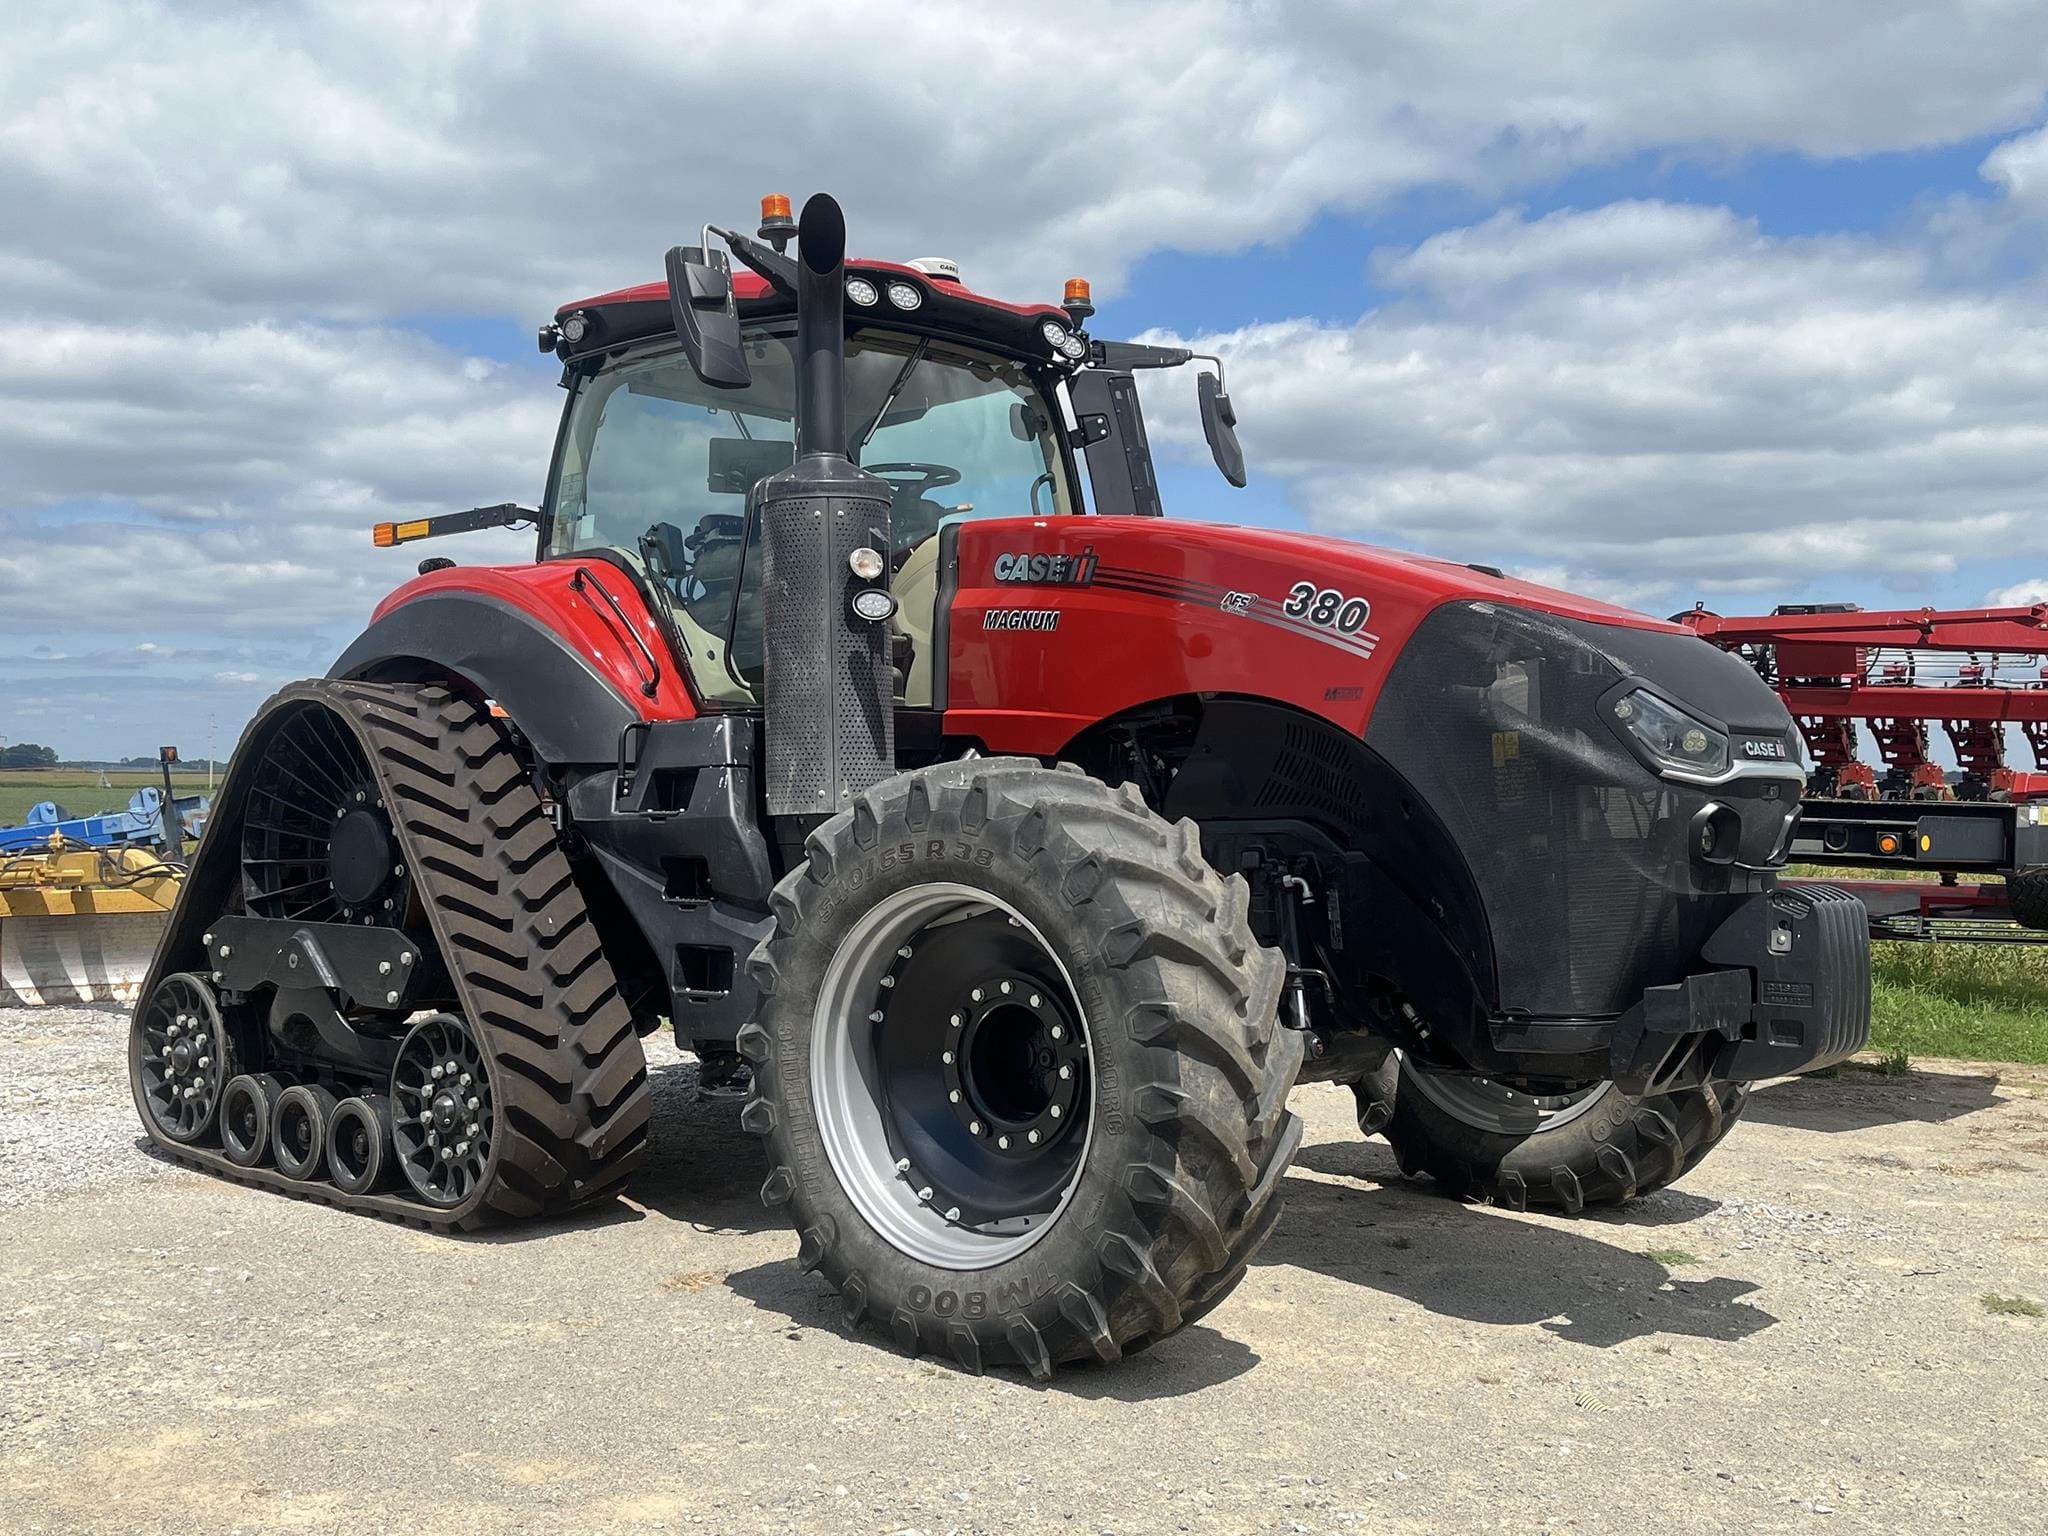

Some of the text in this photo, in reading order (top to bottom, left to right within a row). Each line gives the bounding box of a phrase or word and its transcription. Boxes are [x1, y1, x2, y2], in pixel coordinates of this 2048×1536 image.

[994, 552, 1069, 582] CASE
[1221, 591, 1251, 609] AFS
[1283, 581, 1370, 636] 380
[983, 610, 1060, 630] MAGNUM
[1745, 741, 1776, 757] CASE
[925, 839, 946, 861] R
[954, 842, 995, 869] 38
[907, 1284, 988, 1320] 800
